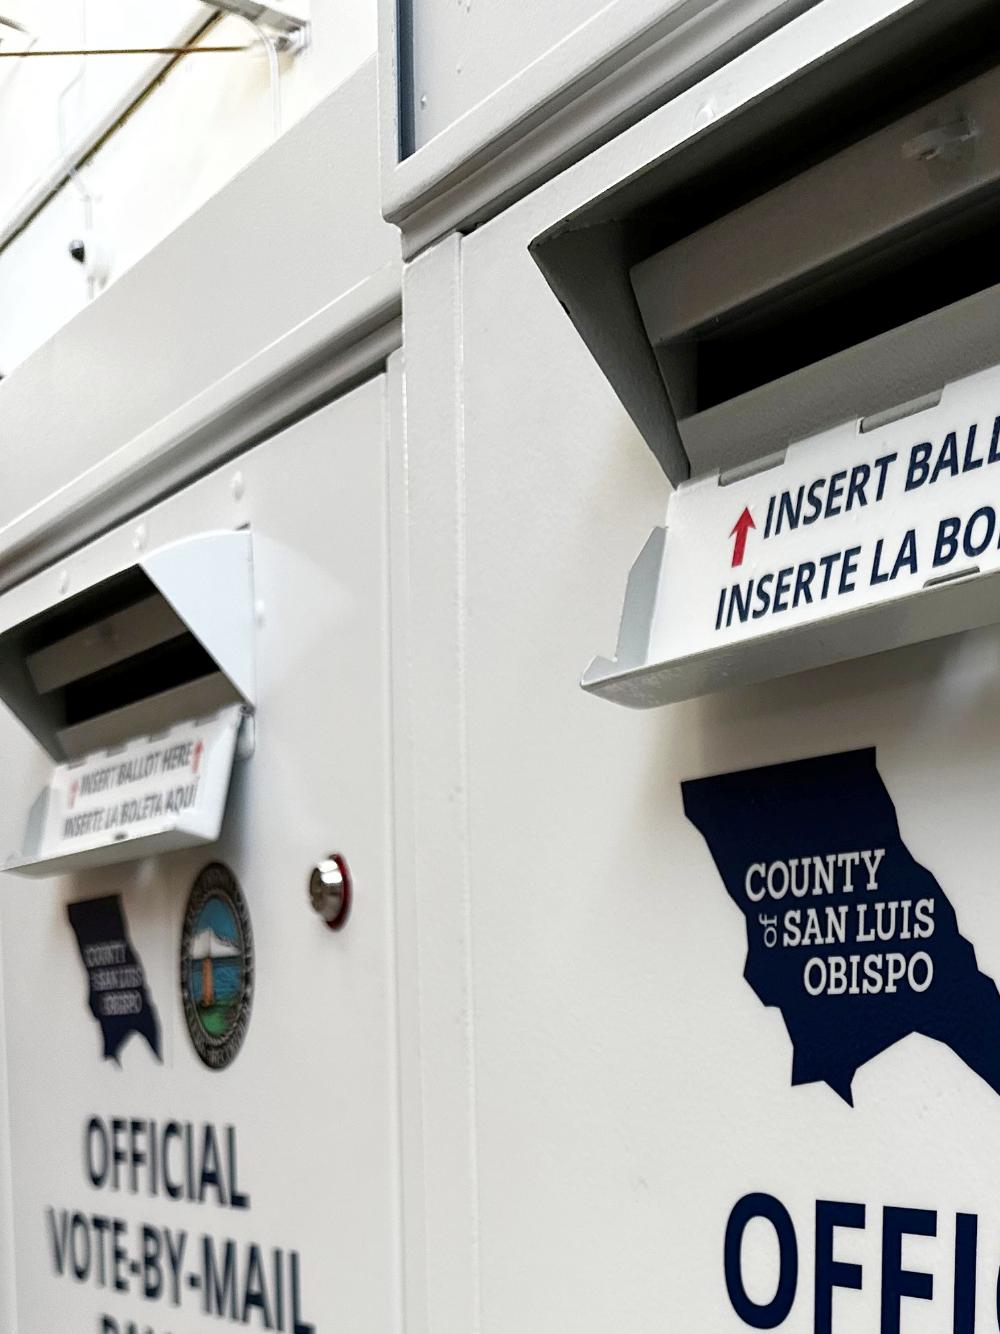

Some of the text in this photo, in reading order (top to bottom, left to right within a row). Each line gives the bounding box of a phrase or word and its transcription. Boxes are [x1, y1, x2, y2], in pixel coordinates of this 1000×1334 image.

[763, 451, 897, 539] INSERT
[715, 549, 859, 630] INSERTE
[871, 529, 918, 585] LA
[745, 849, 885, 901] COUNTY
[759, 898, 935, 948] of SAN LUIS
[804, 951, 934, 996] OBISPO
[82, 1115, 250, 1209] OFFICIAL
